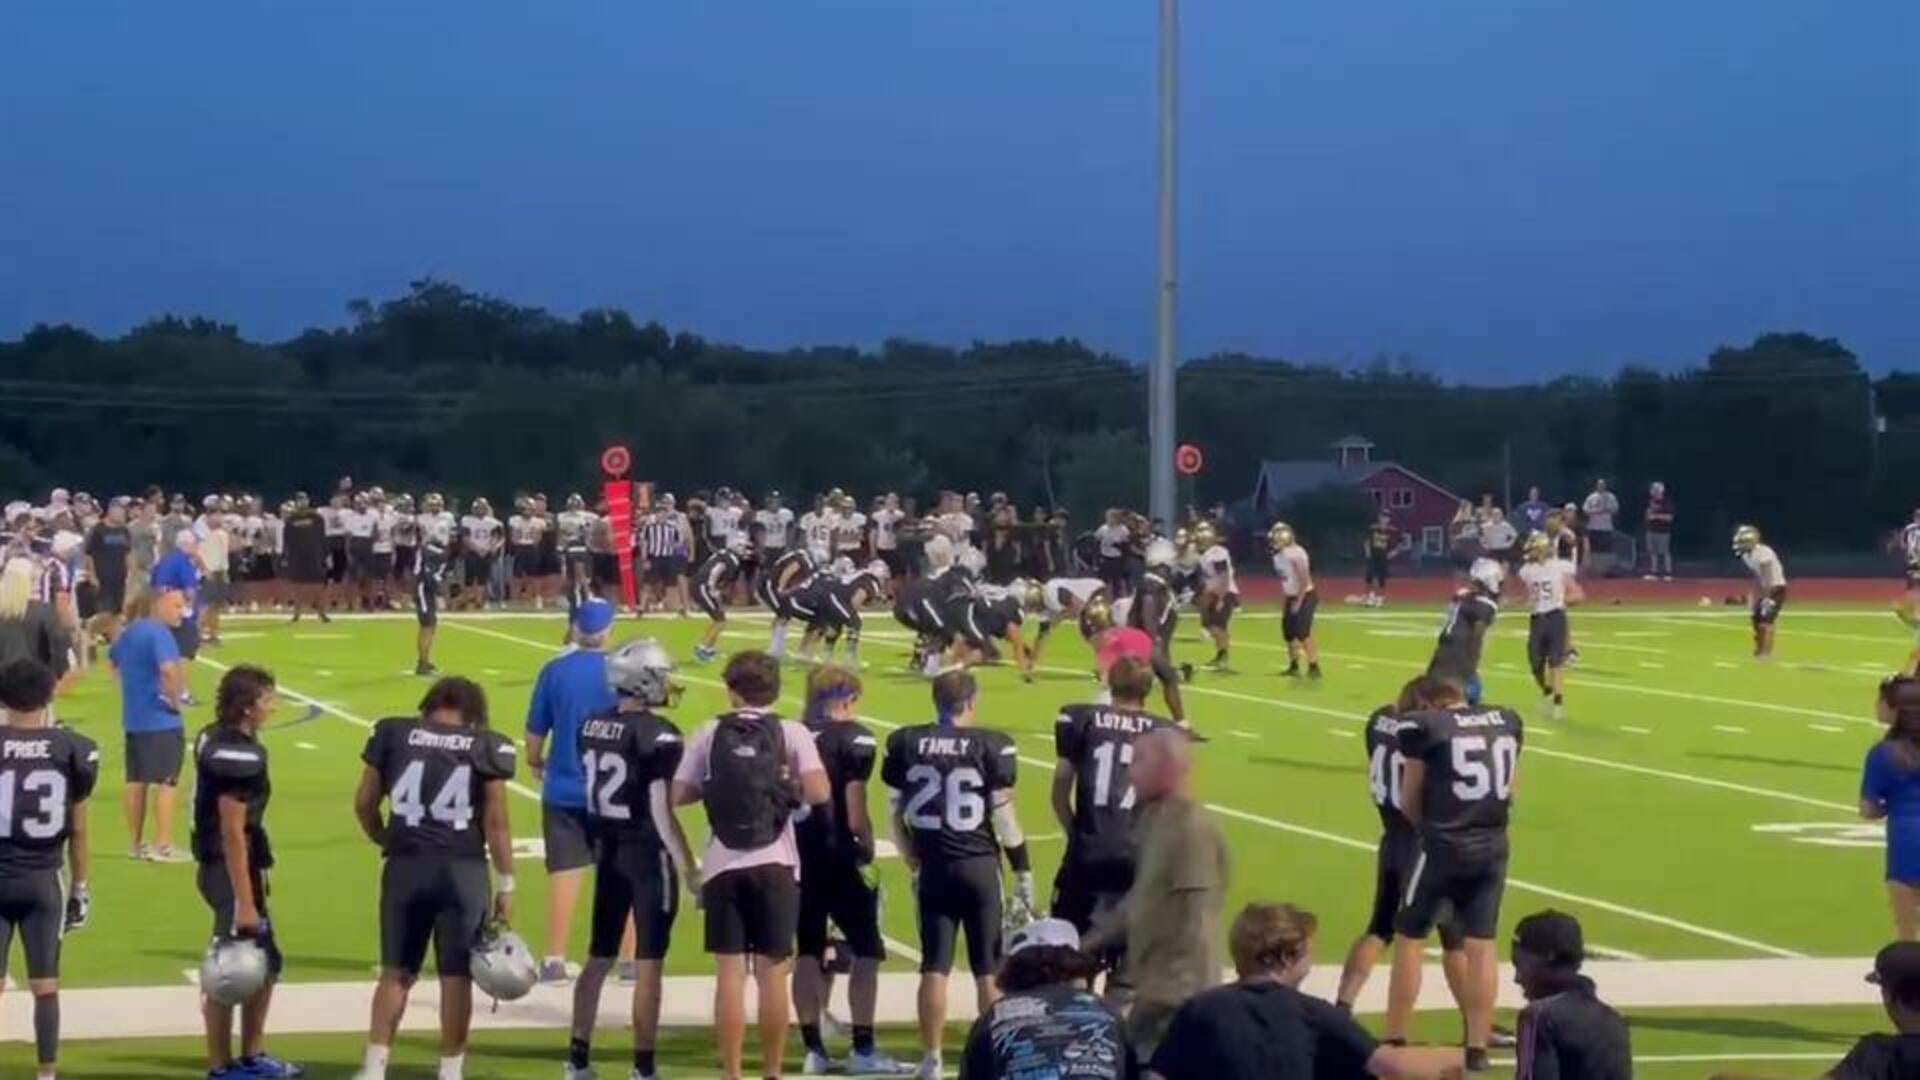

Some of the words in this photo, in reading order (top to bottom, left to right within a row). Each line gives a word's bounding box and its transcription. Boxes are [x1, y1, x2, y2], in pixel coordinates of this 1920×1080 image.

[3, 740, 52, 759] PRIDE
[918, 738, 970, 755] FAMILY
[1451, 736, 1517, 800] 50
[0, 770, 66, 838] 13
[391, 760, 473, 830] 44
[583, 749, 631, 819] 12
[903, 764, 984, 831] 26
